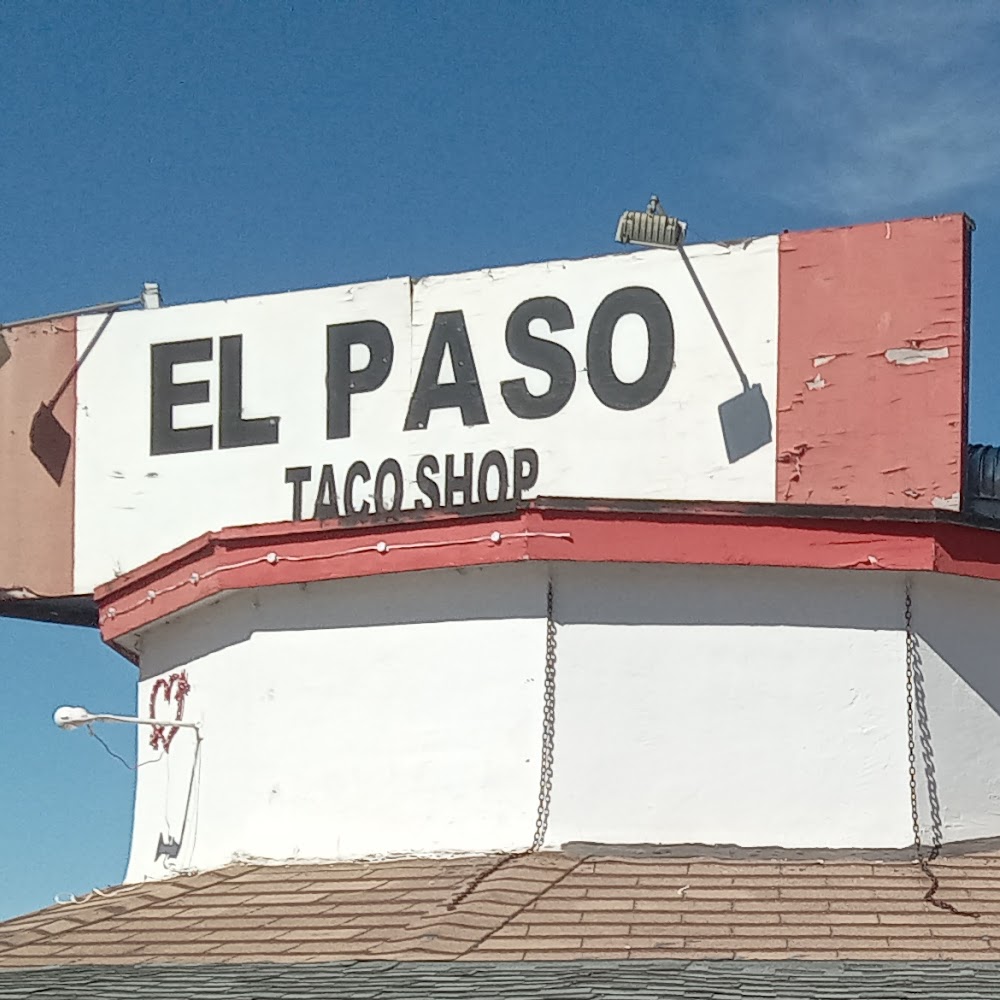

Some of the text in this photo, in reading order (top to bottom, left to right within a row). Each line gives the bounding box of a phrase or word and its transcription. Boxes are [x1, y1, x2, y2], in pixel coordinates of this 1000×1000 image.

[150, 286, 676, 456] EL PASO
[285, 448, 540, 521] TACO SHOP
